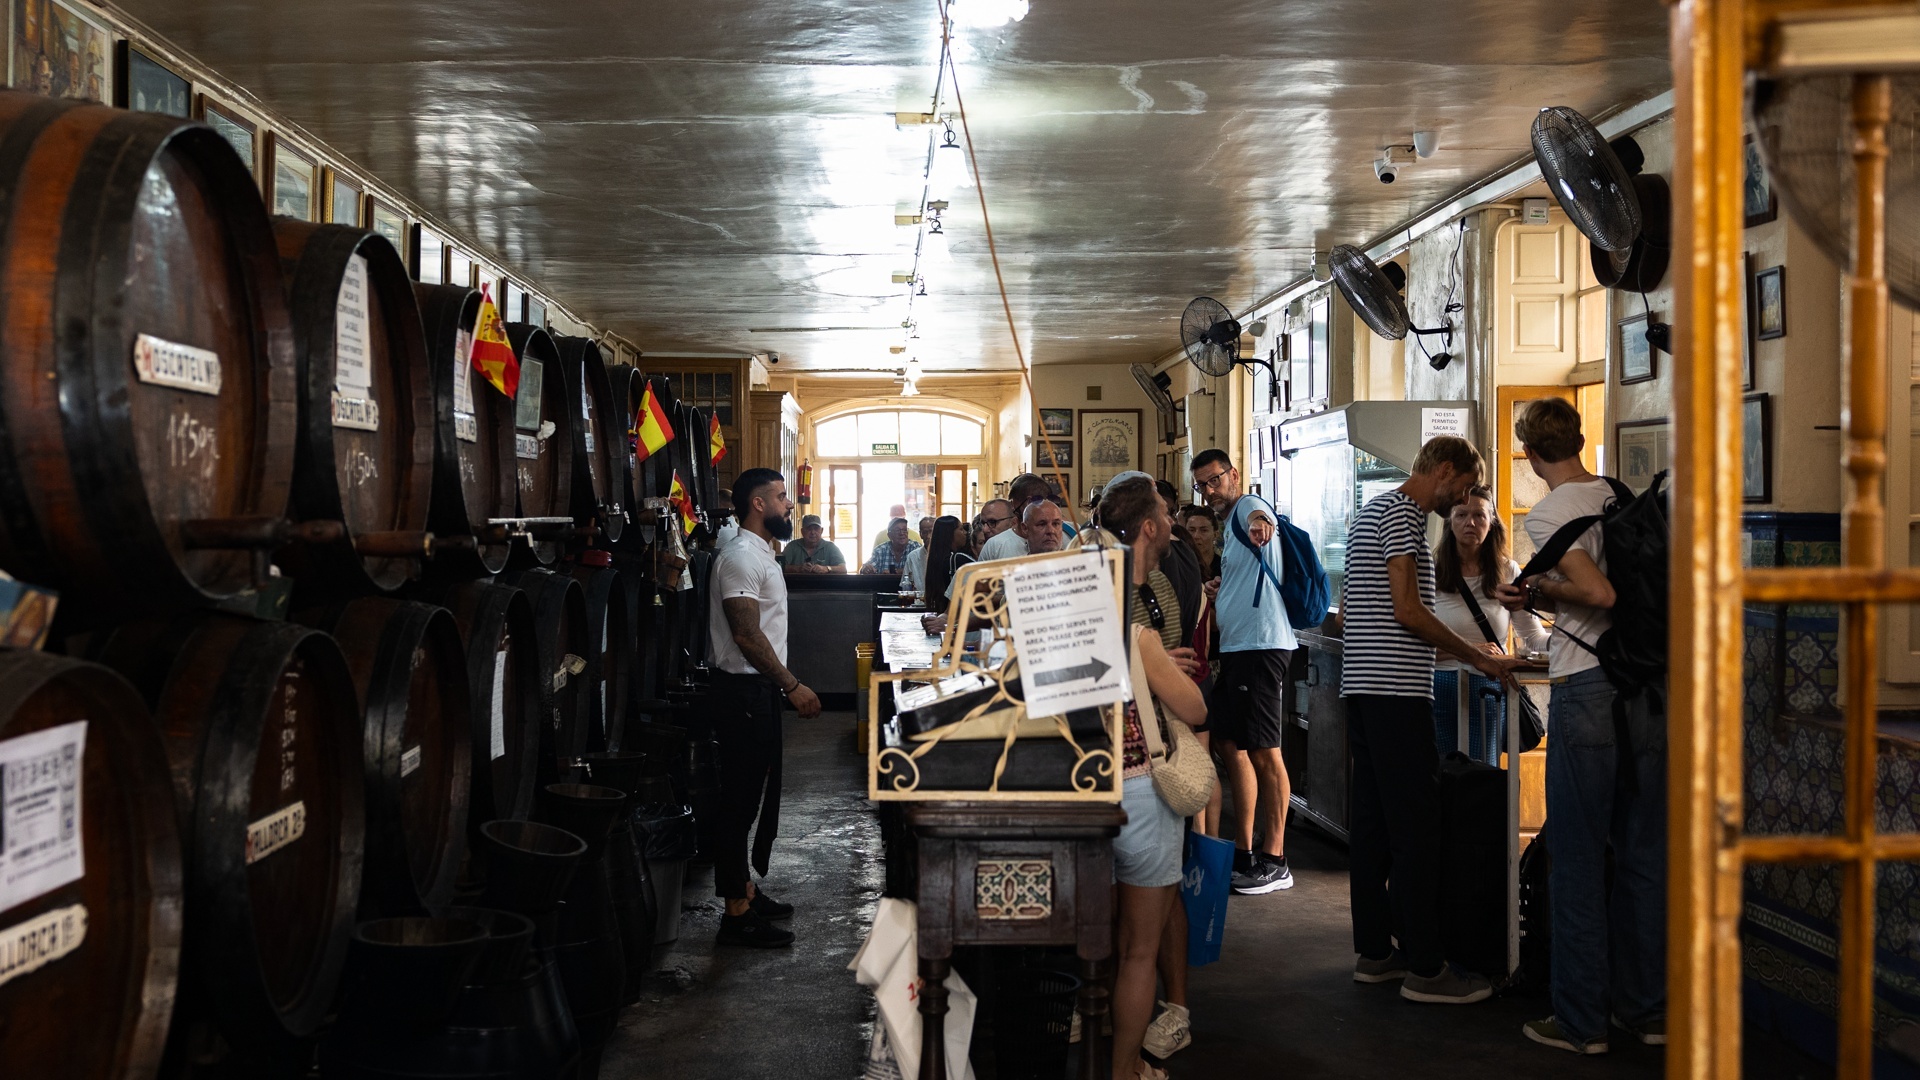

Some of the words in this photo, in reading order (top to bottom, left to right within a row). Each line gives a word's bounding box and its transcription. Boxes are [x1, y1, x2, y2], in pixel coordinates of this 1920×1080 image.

[1027, 568, 1070, 580] ATENDEMOS
[1016, 585, 1032, 593] ESTA
[1047, 584, 1098, 598] CONSUMICIÓN
[1066, 620, 1087, 629] SERVE
[1048, 633, 1072, 641] PLEASE
[1074, 628, 1097, 637] ORDER
[1048, 644, 1070, 652] DRINK
[1079, 683, 1120, 695] COLABORACIÓN
